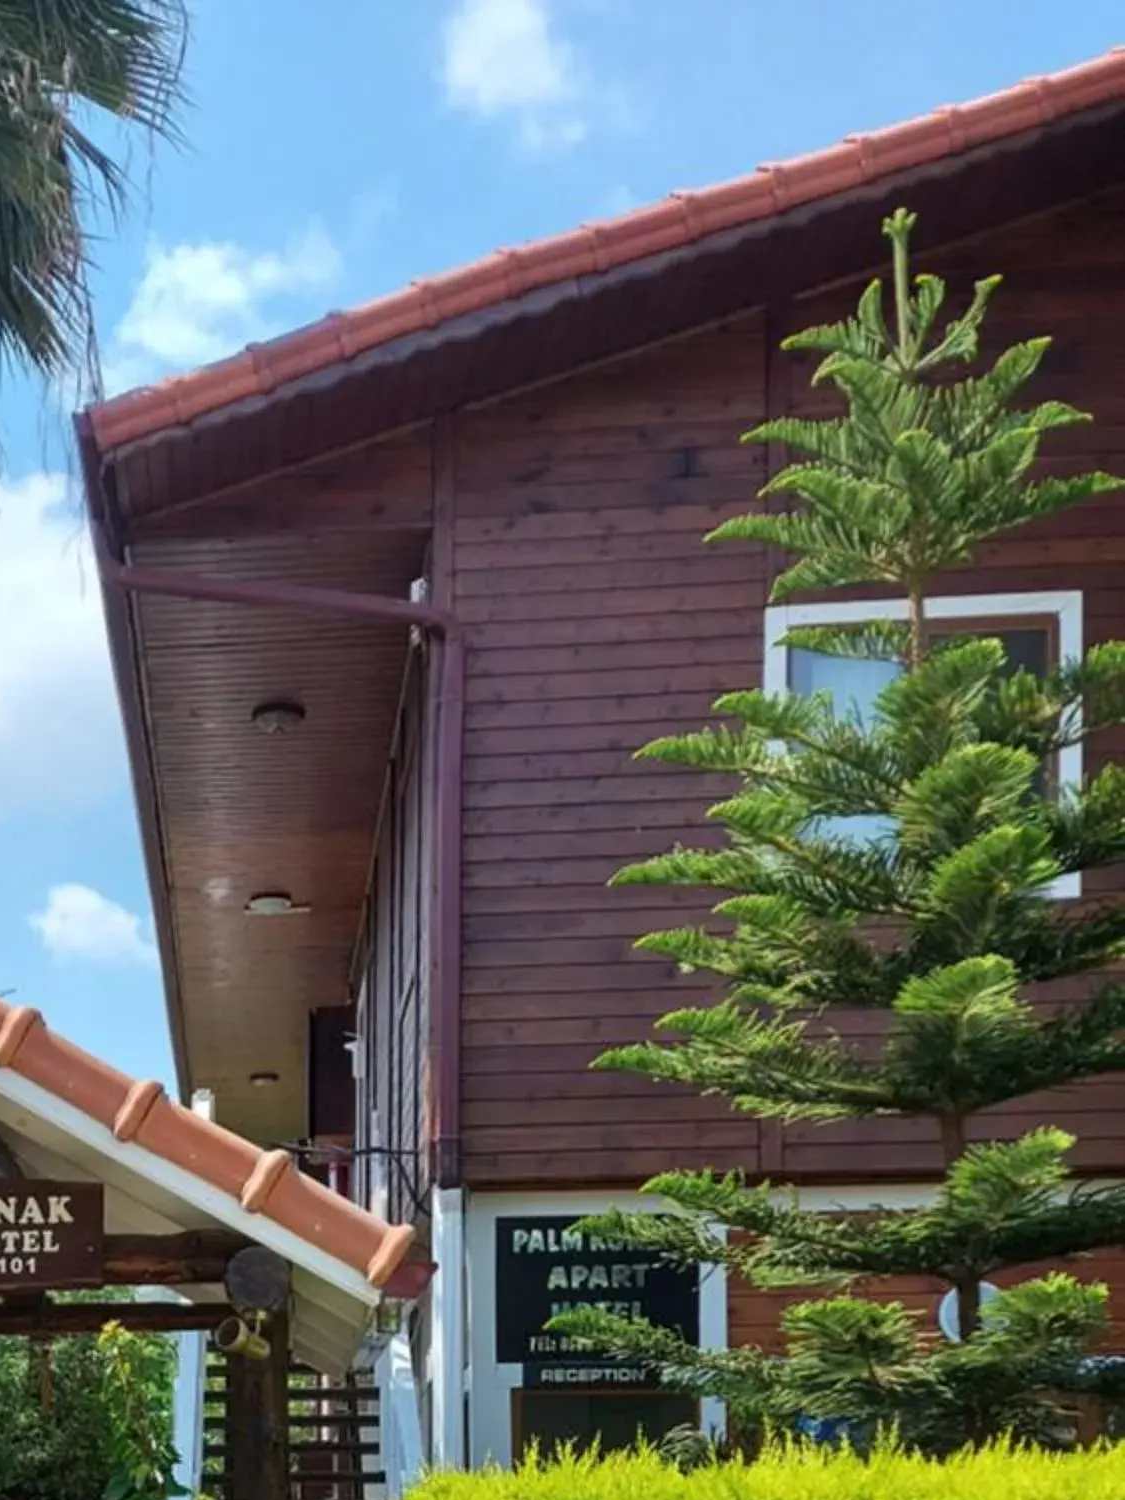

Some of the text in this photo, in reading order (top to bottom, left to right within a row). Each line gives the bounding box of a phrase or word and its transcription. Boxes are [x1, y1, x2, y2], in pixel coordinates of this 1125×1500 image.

[512, 1228, 583, 1253] PALM
[546, 1263, 650, 1291] APART
[540, 1367, 646, 1382] RECEPTION
